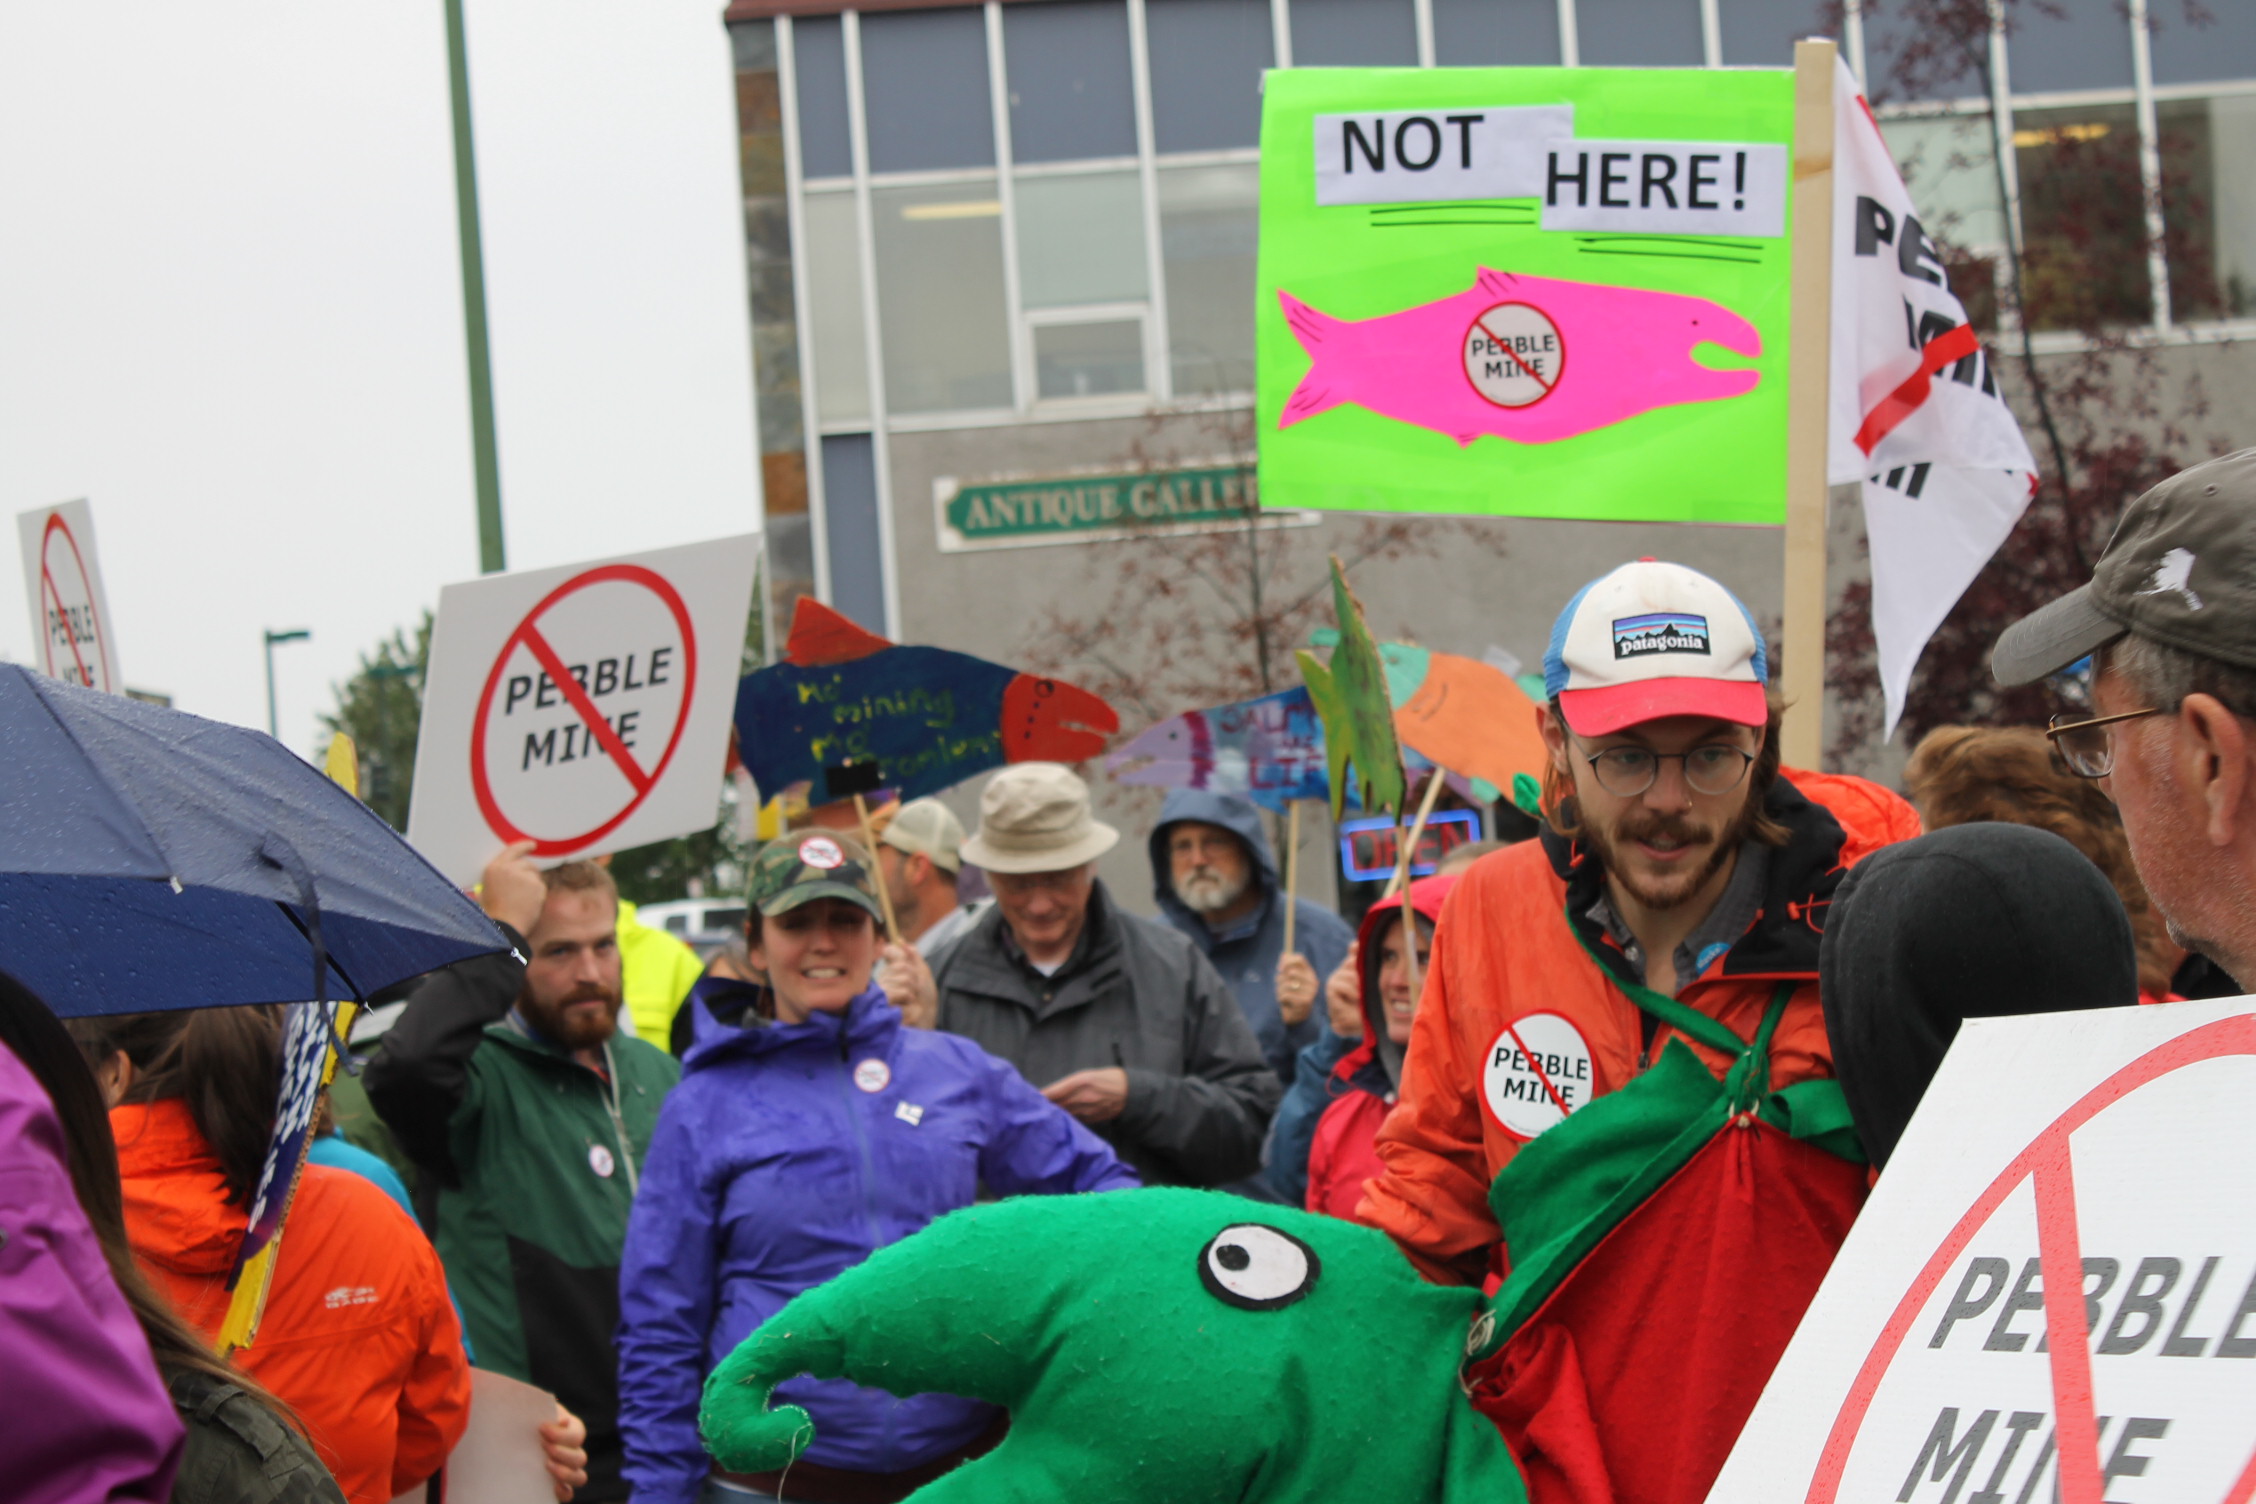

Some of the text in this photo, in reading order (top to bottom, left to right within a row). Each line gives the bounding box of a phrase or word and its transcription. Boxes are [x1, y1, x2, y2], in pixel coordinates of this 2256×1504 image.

[1342, 114, 1485, 174] NOT
[1546, 151, 1746, 211] HERE!
[1472, 334, 1556, 357] PEBBLE
[1485, 358, 1545, 379] MINE
[965, 485, 1123, 530] ANTIQUE
[1621, 634, 1704, 656] patagonia
[504, 647, 674, 716] PEBBLE
[1493, 1046, 1589, 1081] PEBBLE
[1503, 1077, 1575, 1108] MINE
